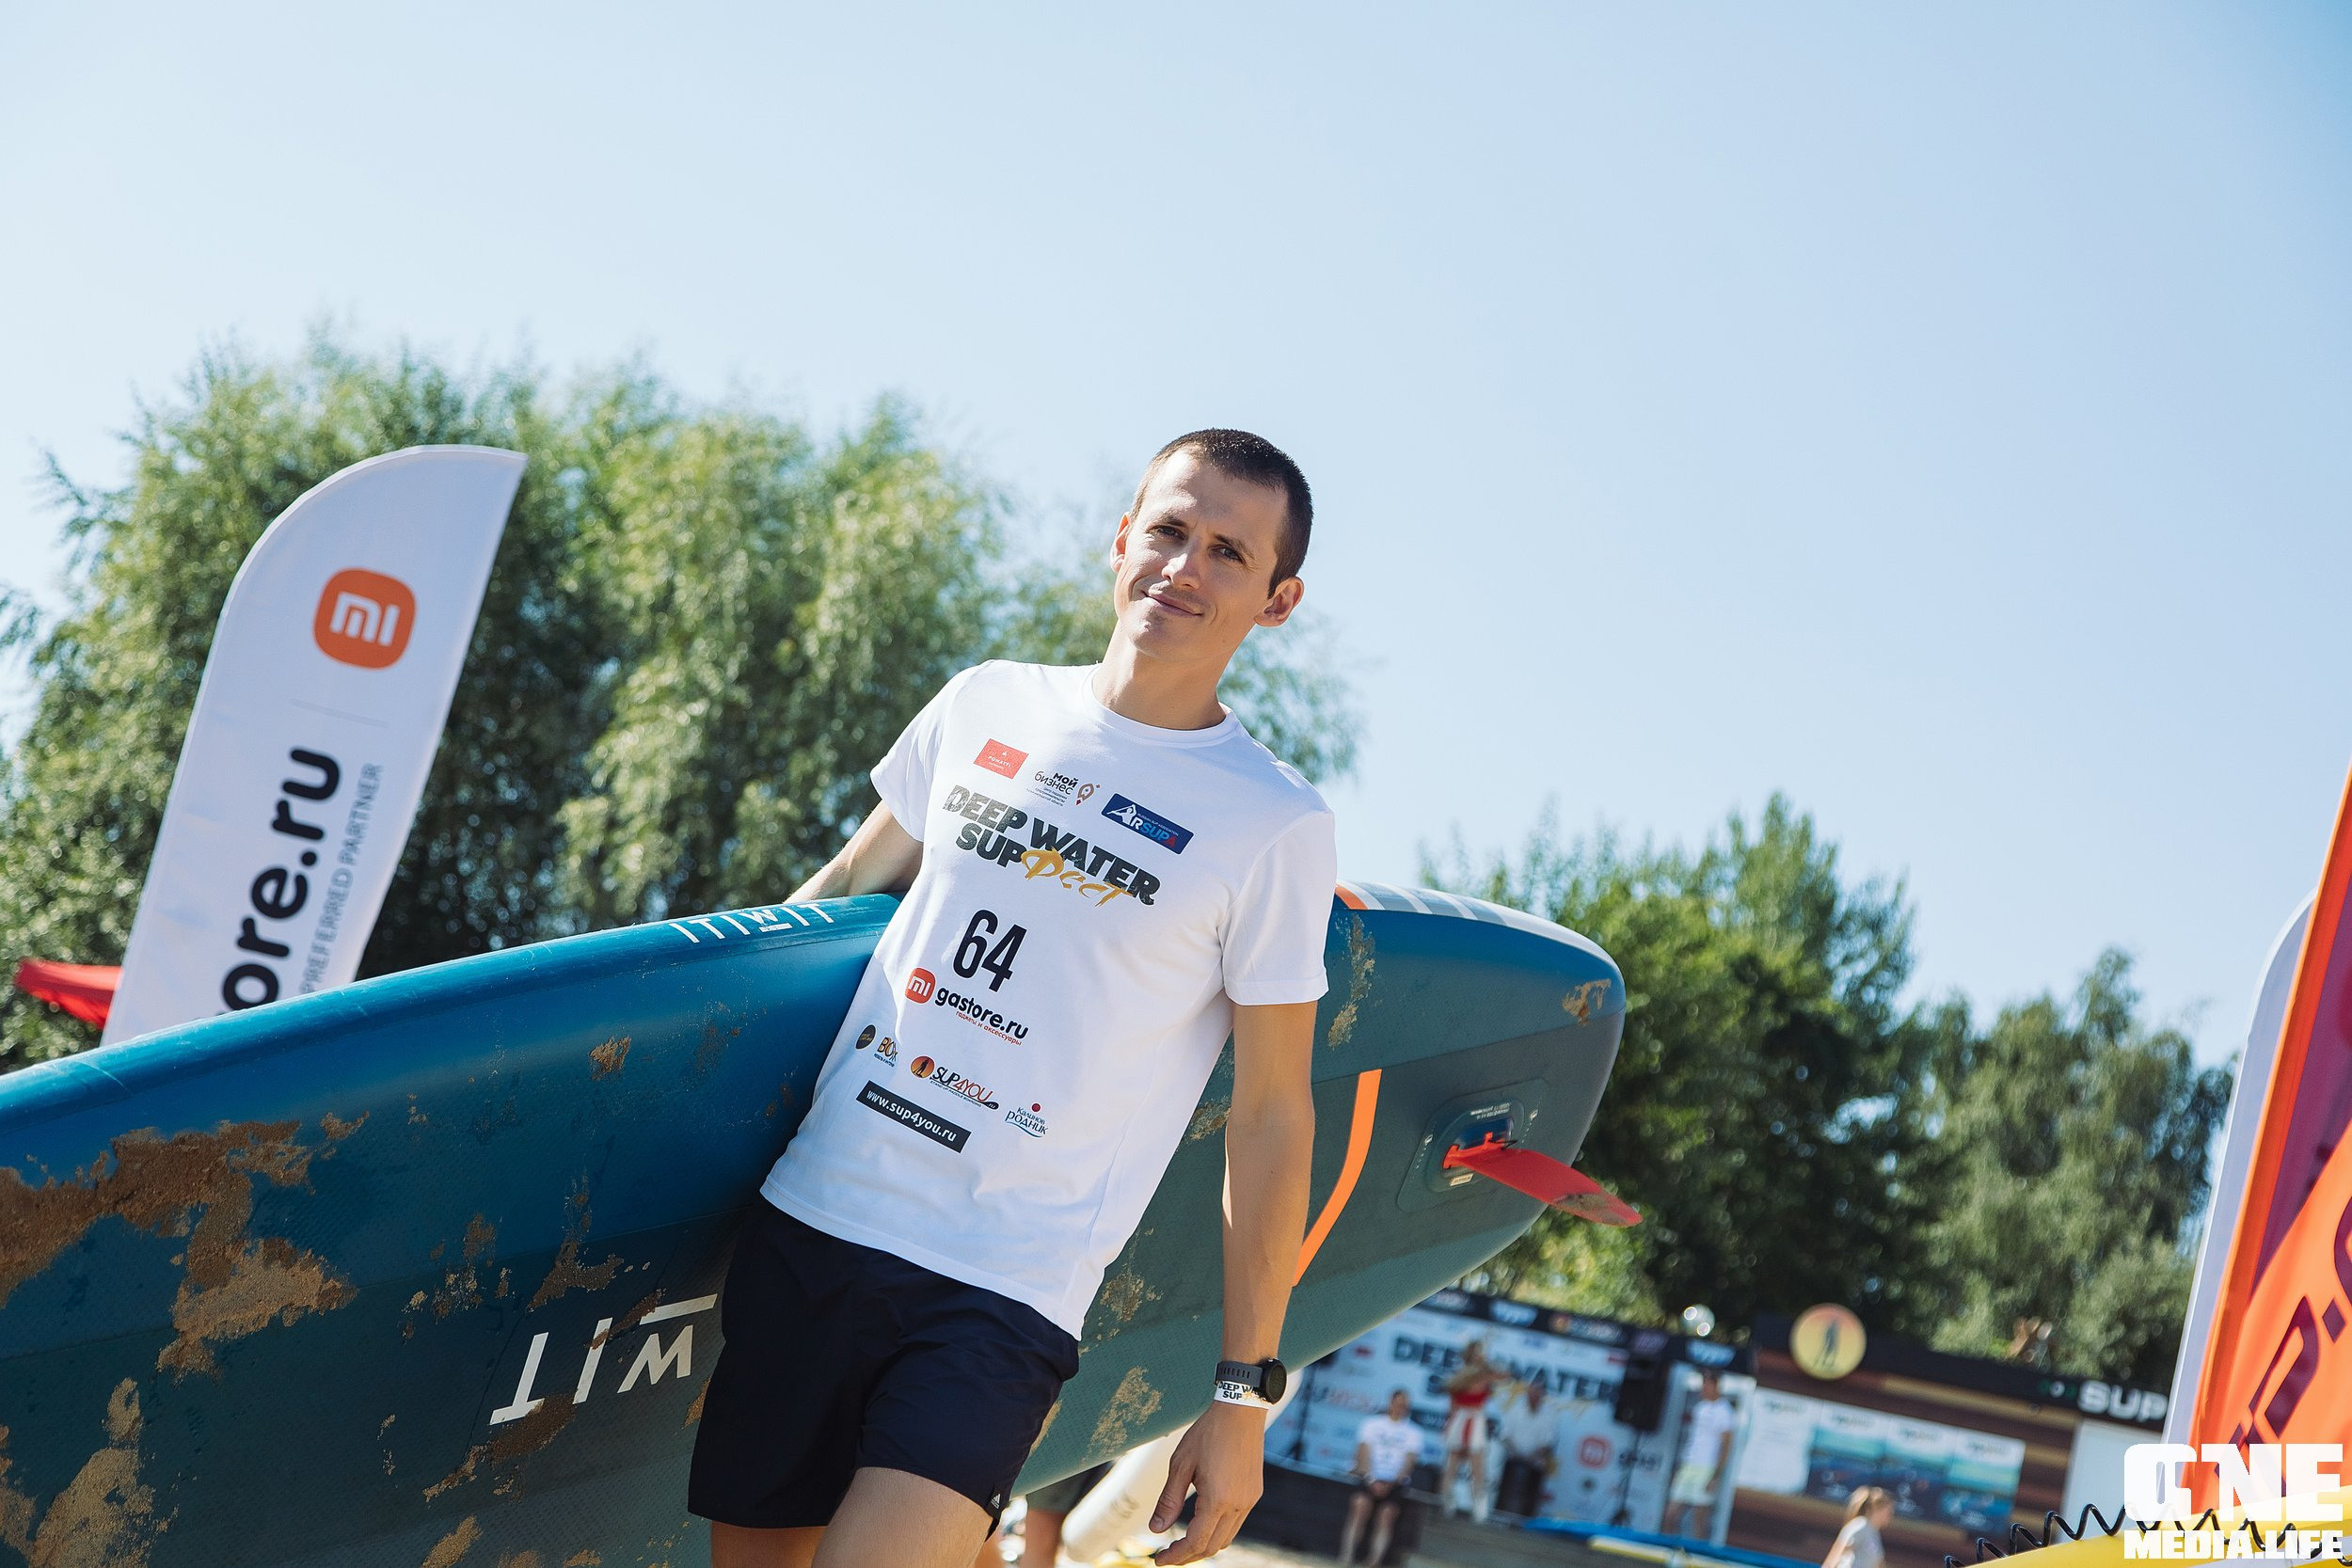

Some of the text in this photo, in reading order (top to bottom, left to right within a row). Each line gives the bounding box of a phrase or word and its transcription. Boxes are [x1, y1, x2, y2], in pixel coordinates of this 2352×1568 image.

[1034, 770, 1074, 796] бизнес
[1053, 772, 1079, 788] мой
[339, 762, 384, 865] PARTNER
[943, 784, 1162, 906] DEEP WATER
[955, 821, 1025, 868] SUP
[216, 746, 342, 1016] ore.ru
[952, 909, 1027, 993] 64
[934, 987, 1029, 1039] gastore.ru
[983, 1024, 1023, 1046] аксессуары
[932, 1066, 993, 1102] SUP4YOU
[866, 1089, 958, 1143] www.sup4you.ru
[1218, 1381, 1240, 1392] DEEP
[1222, 1391, 1243, 1401] SUP
